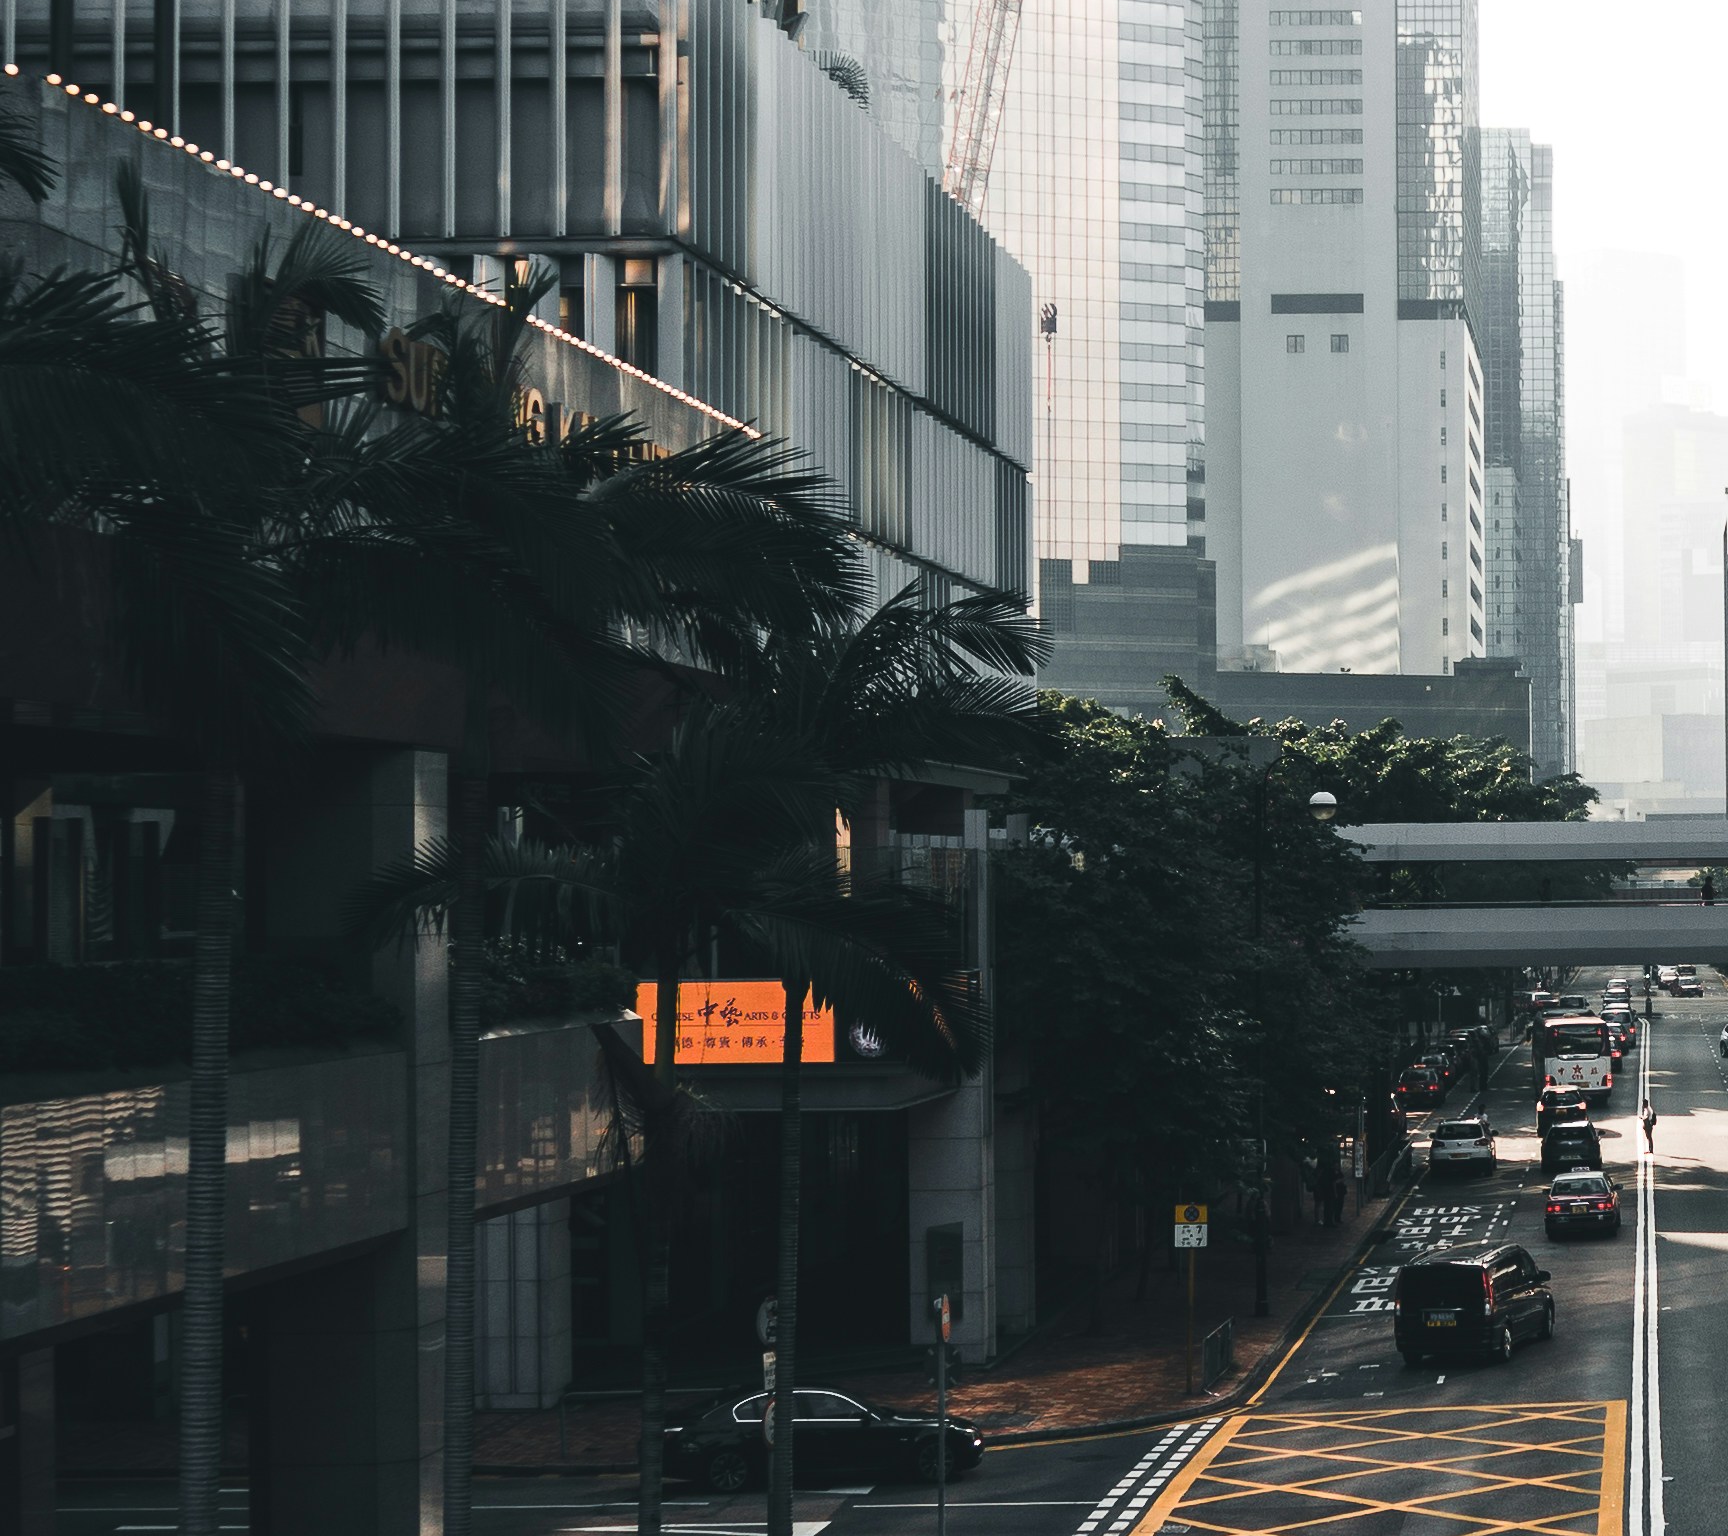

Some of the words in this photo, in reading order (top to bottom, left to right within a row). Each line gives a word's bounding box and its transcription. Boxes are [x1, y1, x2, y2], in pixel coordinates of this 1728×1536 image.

[744, 1011, 768, 1021] ARTS
[1413, 1205, 1482, 1216] BUS
[1396, 1215, 1482, 1226] STOP
[1395, 1225, 1473, 1239] 巴士
[1350, 1275, 1396, 1294] 巴
